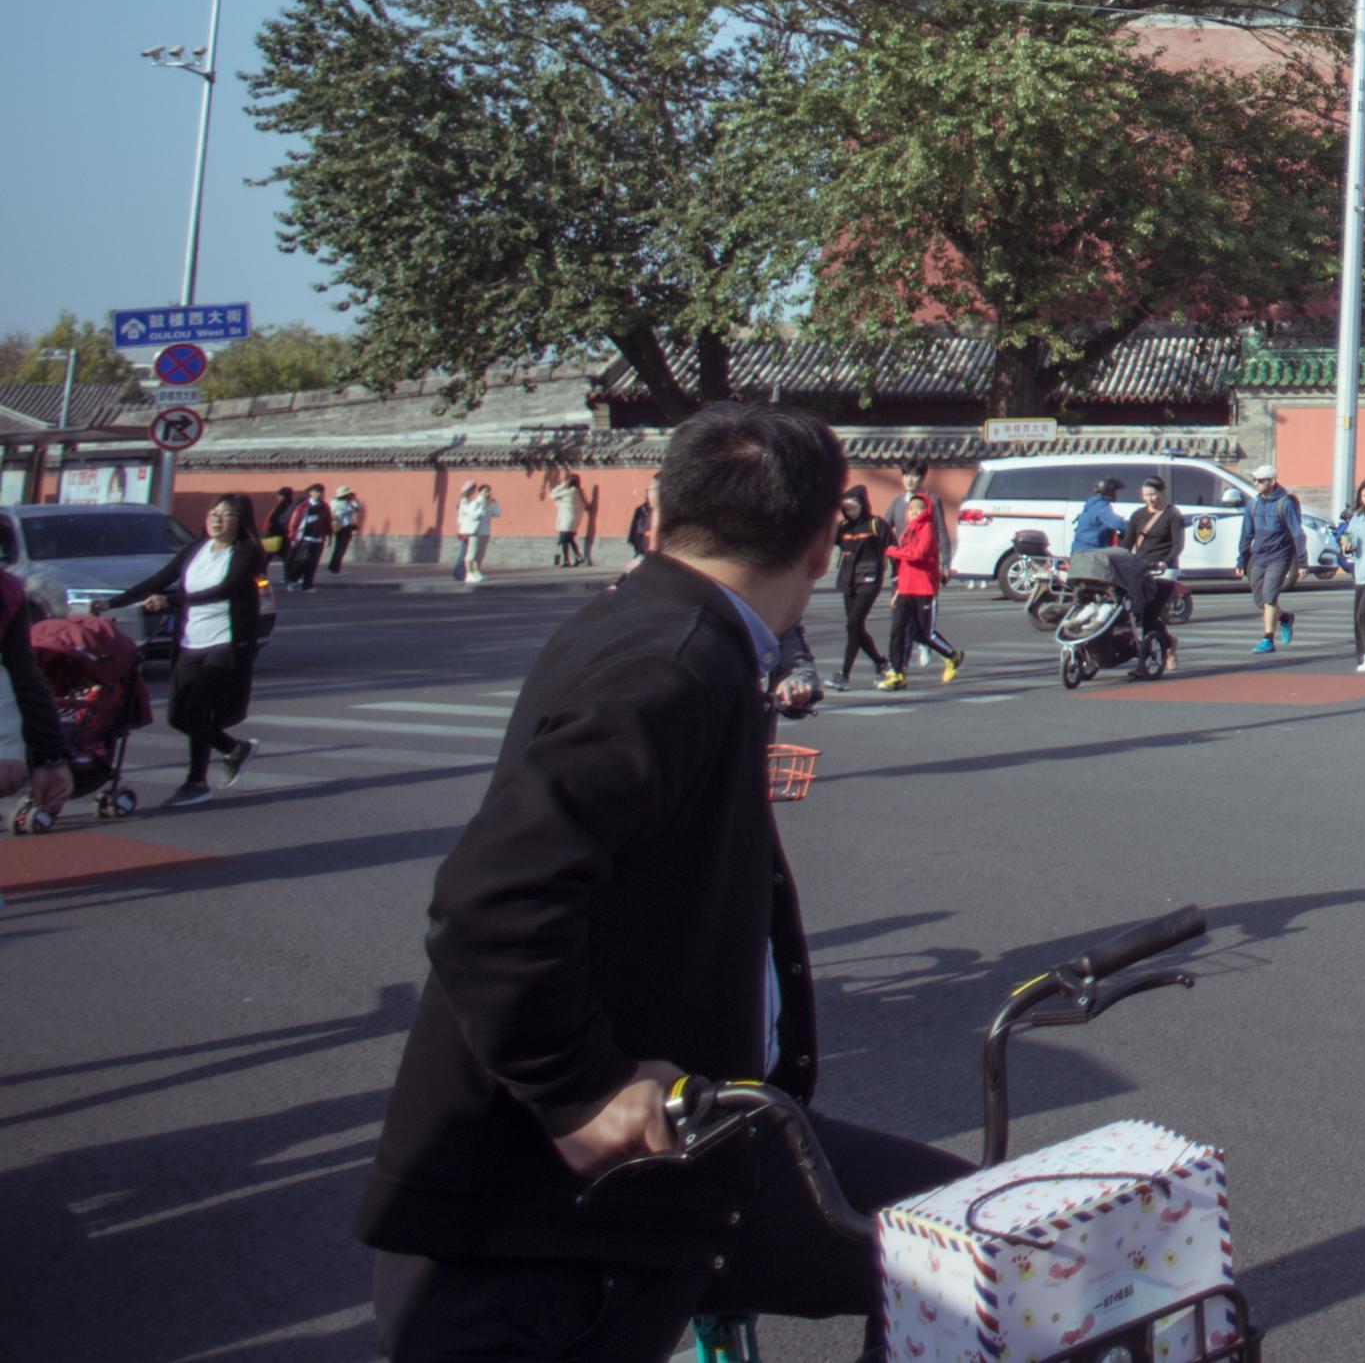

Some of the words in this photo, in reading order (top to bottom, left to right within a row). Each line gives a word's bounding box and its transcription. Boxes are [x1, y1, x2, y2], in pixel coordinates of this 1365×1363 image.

[149, 309, 242, 329] 鼓楼西大街
[149, 330, 191, 341] GULOU
